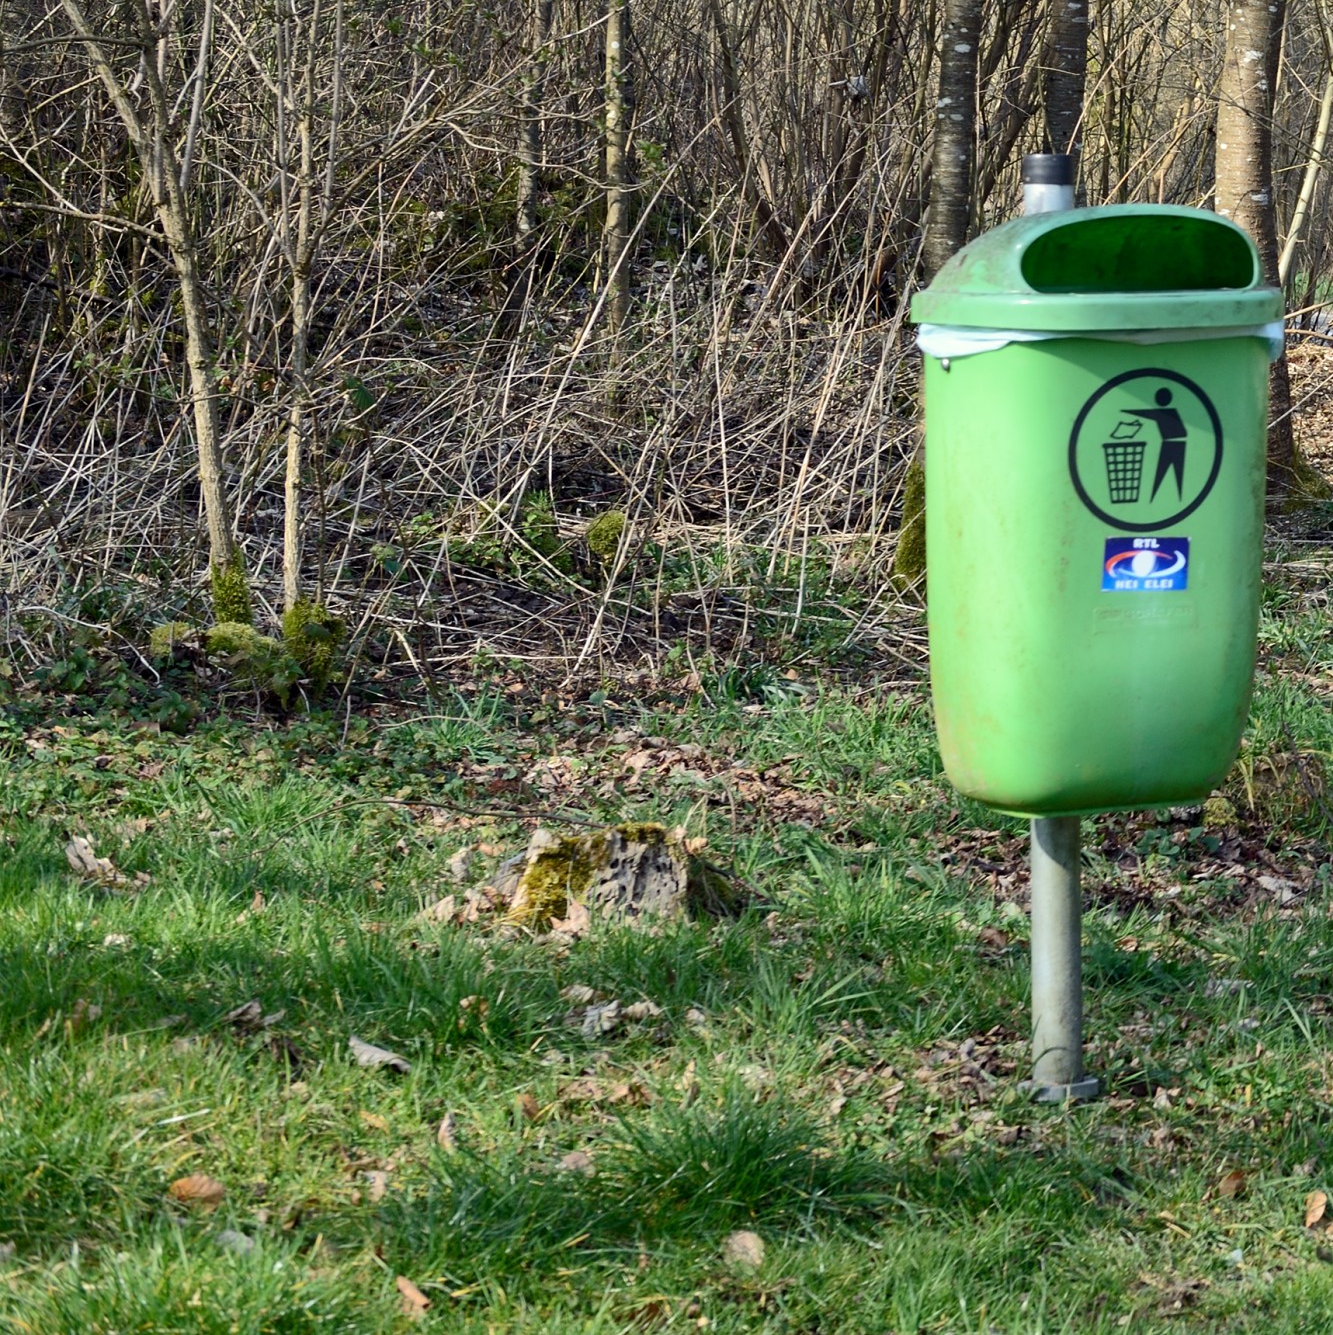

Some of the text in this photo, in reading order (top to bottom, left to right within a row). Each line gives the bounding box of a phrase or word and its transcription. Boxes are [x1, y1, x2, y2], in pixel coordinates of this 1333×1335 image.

[1132, 538, 1160, 549] RTL
[1114, 579, 1174, 590] HEI ELEI
